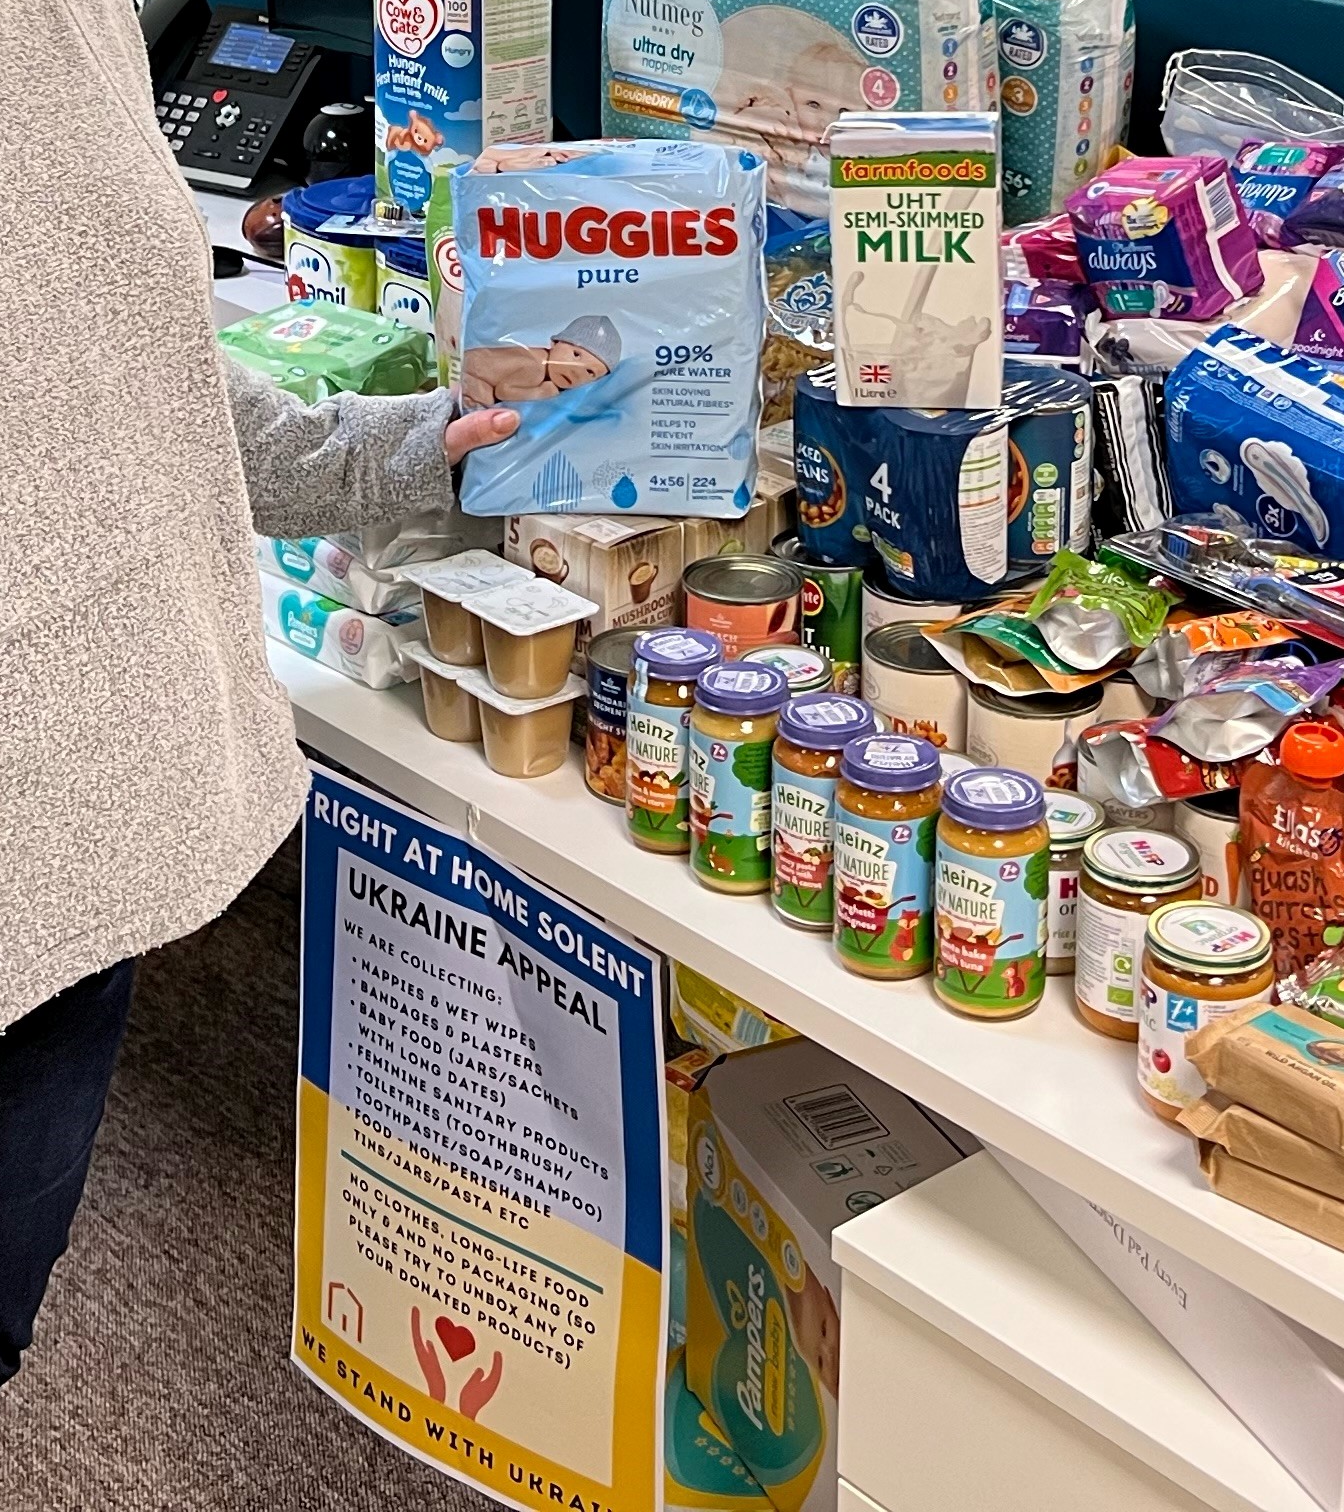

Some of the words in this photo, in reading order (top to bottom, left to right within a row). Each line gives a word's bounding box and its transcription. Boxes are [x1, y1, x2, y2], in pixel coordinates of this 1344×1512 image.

[446, 0, 468, 13] 100
[389, 17, 421, 36] Gate
[443, 45, 472, 57] Hungry
[632, 35, 667, 58] ultra
[670, 43, 695, 68] dry
[864, 36, 890, 50] RATED
[1007, 45, 1033, 63] RATED
[387, 53, 427, 79] Hungry
[641, 57, 684, 76] nappies
[391, 69, 422, 90] infant
[422, 80, 451, 106] milk
[614, 84, 676, 110] DoubleDRY
[871, 79, 885, 98] 4
[1011, 87, 1025, 105] 3
[840, 158, 987, 182] farmfoods
[886, 192, 942, 210] UHT
[477, 205, 739, 260] HUGGIES
[843, 211, 985, 230] SEMI-SKIMMED
[857, 230, 976, 264] MILK
[1087, 245, 1158, 279] always
[576, 264, 640, 290] pure
[655, 344, 713, 367] 99%
[1290, 342, 1344, 359] goodnight
[688, 367, 732, 378] WATER
[651, 387, 675, 396] SKIN
[675, 388, 712, 397] LOVING
[651, 399, 695, 408] NATURAL
[861, 387, 886, 400] Litre
[650, 430, 694, 440] PREVENT
[651, 419, 681, 429] HELPS
[683, 420, 697, 429] TO
[650, 442, 672, 451] SKIN
[691, 477, 717, 488] 224
[796, 457, 830, 485] EANS
[869, 461, 893, 505] 4
[864, 497, 902, 531] PACK
[507, 516, 520, 544] 5
[611, 590, 676, 630] MUSHROOM
[629, 715, 675, 744] Heinz
[636, 740, 679, 764] NATURE
[871, 758, 914, 769] Heinz
[776, 785, 827, 817] Heinz
[1107, 804, 1150, 820] SAVERS
[784, 813, 830, 839] NATURE
[1272, 803, 1321, 849] Ella's
[836, 823, 885, 859] Heinz
[1275, 835, 1320, 862] kitchen
[842, 852, 890, 881] NATURE
[941, 863, 993, 897] Heinz
[313, 790, 398, 854] RIGHT
[402, 837, 443, 876] AT
[451, 855, 529, 928] HOME
[536, 910, 646, 998] SOLENT
[948, 892, 998, 921] NATURE
[343, 917, 365, 940] WE
[368, 933, 396, 957] ARE
[399, 949, 504, 1006] COLLECTING:
[348, 866, 488, 959] UKRAINE
[496, 941, 608, 1036] APPEAL
[960, 959, 985, 973] tuna
[360, 957, 425, 1002] NAPPIES
[430, 994, 440, 1008] &
[445, 1000, 479, 1026] WET
[485, 1017, 537, 1053] WIPES
[1172, 999, 1193, 1018] 7+
[359, 979, 440, 1031] BANDAGES
[445, 1024, 455, 1038] &
[461, 1031, 543, 1077] PLASTERS
[357, 1021, 395, 1054] WITH
[399, 1046, 442, 1077] LONG
[447, 1070, 507, 1108] DATES)
[358, 1001, 397, 1032] BABY
[400, 1024, 443, 1056] FOOD
[448, 1046, 580, 1122] (JARS/SACHETS
[1264, 1049, 1287, 1066] WILD
[1287, 1060, 1322, 1083] ARGAN
[1321, 1078, 1338, 1091] OIL
[355, 1065, 442, 1123] TOILETRIES
[445, 1112, 575, 1182] (TOOTHBRUSH/
[356, 1044, 428, 1094] FEMININE
[432, 1086, 518, 1134] SANITARY
[522, 1125, 610, 1181] PRODUCTS
[353, 1107, 393, 1140] FOOD
[408, 1139, 553, 1220] NON-PERISHABLE
[354, 1085, 605, 1224] TOOTHPASTE/SOAP/SHAMPOO)
[352, 1127, 494, 1215] TINS/JARS/PASTA
[498, 1208, 531, 1231] ETC
[349, 1171, 370, 1193] NO
[450, 1230, 539, 1284] LONG-LIFE
[543, 1274, 590, 1309] FOOD
[1127, 1235, 1150, 1273] Pad
[341, 1188, 378, 1221] ONLY
[381, 1214, 392, 1229] &
[395, 1223, 428, 1250] AND
[431, 1242, 456, 1264] NO
[460, 1257, 562, 1318] PACKAGING
[566, 1309, 597, 1336] (SO
[348, 1214, 399, 1256] PLEASE
[402, 1247, 432, 1274] TRY
[436, 1268, 457, 1288] TO
[461, 1279, 520, 1320] UNBOX
[523, 1312, 559, 1339] ANY
[562, 1332, 586, 1353] OF
[1152, 1259, 1190, 1311] Every
[356, 1239, 395, 1276] YOUR
[398, 1267, 472, 1317] DONATED
[476, 1309, 573, 1371] PRODUCTS)
[736, 1264, 767, 1431] Pampers
[300, 1325, 328, 1365] WE
[335, 1360, 413, 1424] STAND
[424, 1416, 495, 1472] WITH
[508, 1462, 614, 1512] UKRAI
